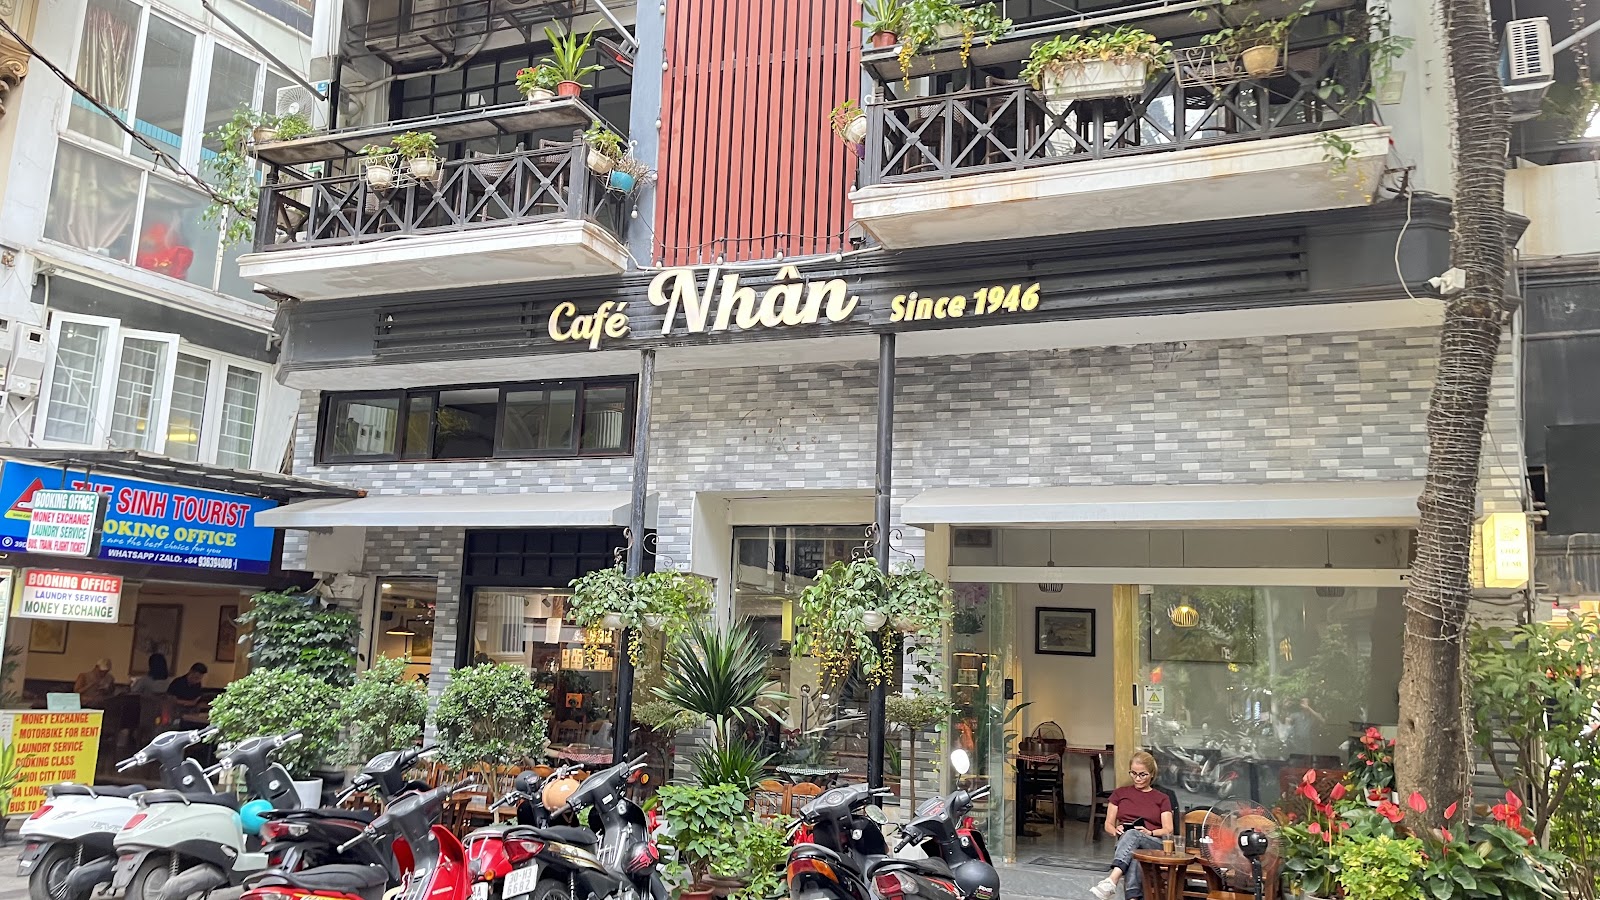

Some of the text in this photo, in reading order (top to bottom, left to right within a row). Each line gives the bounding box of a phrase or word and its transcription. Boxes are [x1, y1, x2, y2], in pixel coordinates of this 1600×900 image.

[548, 266, 859, 349] Café Nhân
[890, 283, 1040, 323] Since 1946
[35, 492, 95, 511] BOOKING OFFICE
[116, 487, 169, 518] SINH
[173, 495, 251, 528] TOURIST
[33, 512, 55, 523] MONEY
[57, 513, 90, 525] EXCHANGE
[31, 524, 87, 539] LAUNDRY SERVICE
[102, 520, 237, 547] OKING OFFICE
[126, 537, 142, 546] the
[144, 538, 163, 549] best
[164, 541, 190, 551] choice
[189, 543, 205, 555] for
[206, 548, 221, 556] you
[108, 549, 154, 561] WHATSAPP
[160, 554, 183, 563] ZALO:
[28, 572, 118, 592] BOOKING OFFICE
[35, 590, 108, 603] LAUNDRY SERVICE
[24, 600, 114, 618] MONEY EXCHANGE
[21, 713, 89, 724] MONEY EXCHANGE
[19, 727, 99, 739] MOTORBIKE FOR RENT
[17, 741, 84, 754] LAUNDRY SERVICE
[15, 755, 75, 768] COOKING CLASS
[39, 770, 57, 781] CITY
[57, 769, 77, 780] TOUR
[12, 786, 22, 798] HA
[9, 801, 26, 812] BUS
[28, 801, 37, 811] TO
